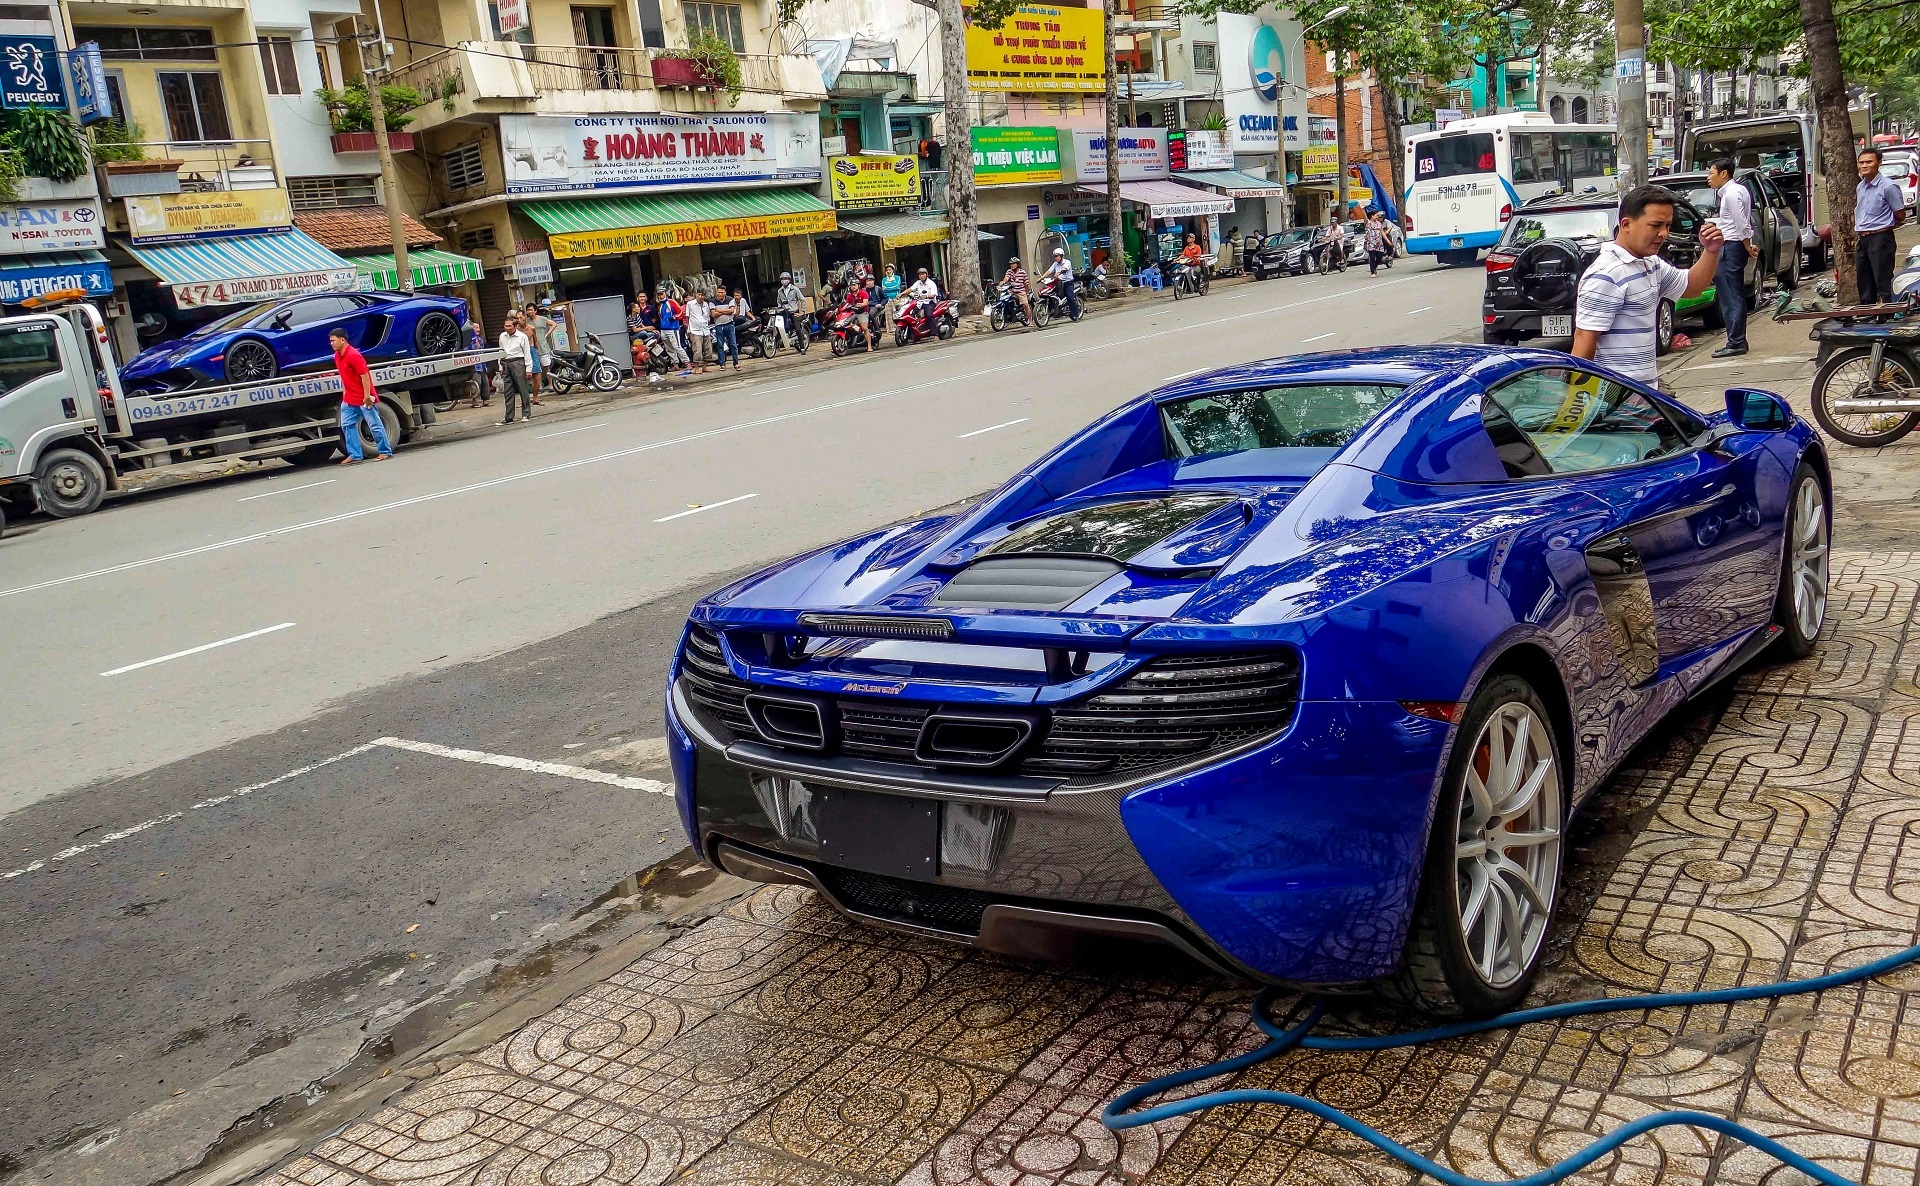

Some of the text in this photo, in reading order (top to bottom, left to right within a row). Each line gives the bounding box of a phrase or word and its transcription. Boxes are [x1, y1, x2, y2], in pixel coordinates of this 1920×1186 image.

[7, 92, 60, 102] PEUGEOT
[609, 117, 623, 127] TY
[627, 117, 658, 127] TNHH
[712, 116, 745, 125] SALON
[1239, 114, 1273, 131] OCEAN
[583, 136, 600, 160] 皇
[605, 125, 746, 160] HOÀNG THÀNH
[986, 148, 1013, 169] THIỆU
[1014, 147, 1034, 167] VIỆC
[1036, 146, 1057, 163] LÀM
[1421, 158, 1433, 172] 45
[1478, 153, 1494, 170] 45
[167, 207, 256, 227] DYNAMO DEMAREURS
[54, 228, 93, 238] TOYOTA
[569, 237, 586, 253] CÔNG
[587, 238, 595, 251] TY
[597, 238, 613, 250] TNHH
[643, 233, 661, 246] SALON
[662, 229, 673, 244] ÔTÔ
[675, 223, 721, 243] HOÀNG
[724, 219, 767, 238] THÀNH
[334, 272, 352, 280] 474
[21, 274, 82, 298] PEUGEOT
[179, 283, 230, 305] 474
[231, 277, 268, 295] DINAMO
[17, 324, 47, 333] ISUZU
[1549, 316, 1564, 326] 51F
[453, 355, 481, 366] SAMCO
[279, 384, 295, 400] HỘ
[132, 393, 239, 420] 0943.247.247
[841, 683, 899, 695] McLaren
